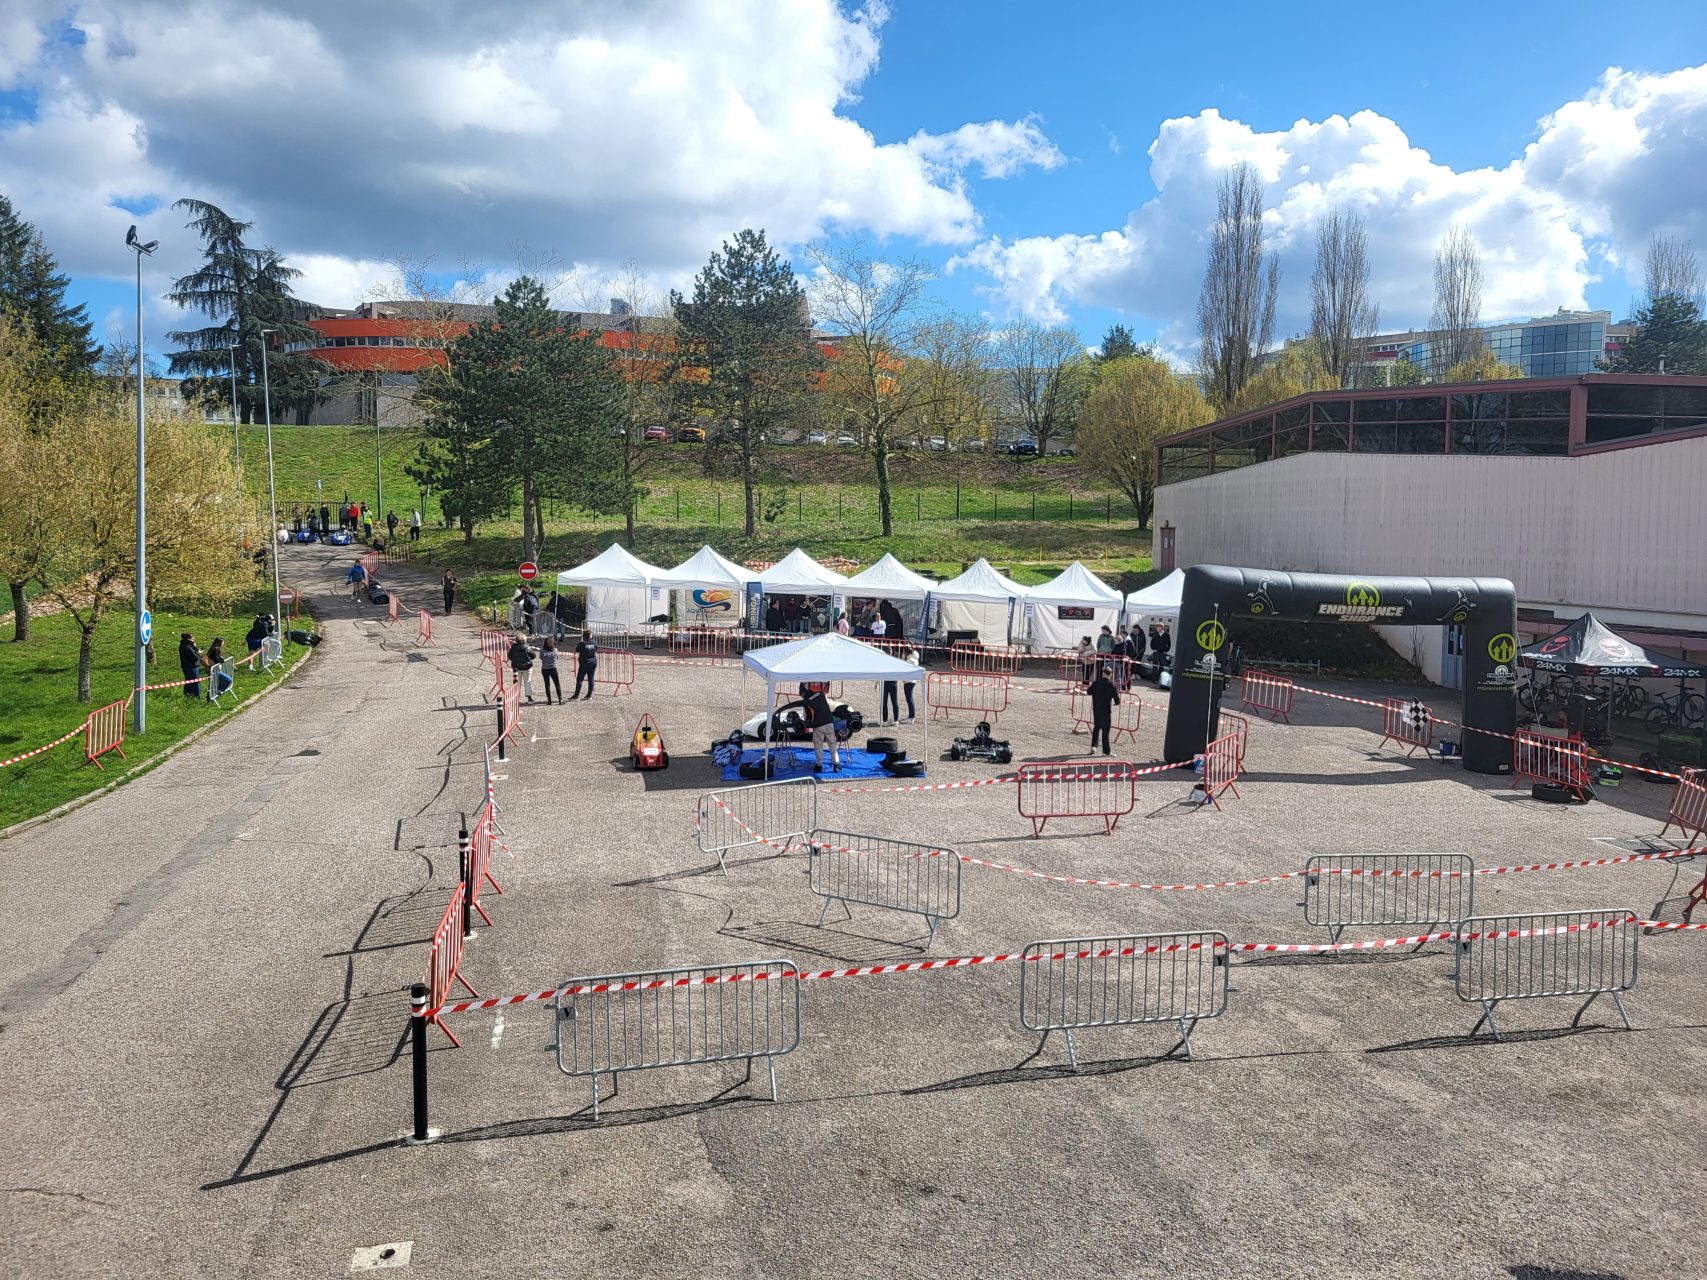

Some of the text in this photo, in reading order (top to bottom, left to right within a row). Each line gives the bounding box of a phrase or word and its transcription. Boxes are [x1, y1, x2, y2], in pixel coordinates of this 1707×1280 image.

[1318, 604, 1404, 616] ENDURANCE
[1339, 615, 1377, 623] SHOP
[1536, 660, 1567, 673] 24MX
[1600, 667, 1639, 676] 24MX
[1663, 668, 1702, 677] 24MX
[563, 1007, 573, 1018] V
